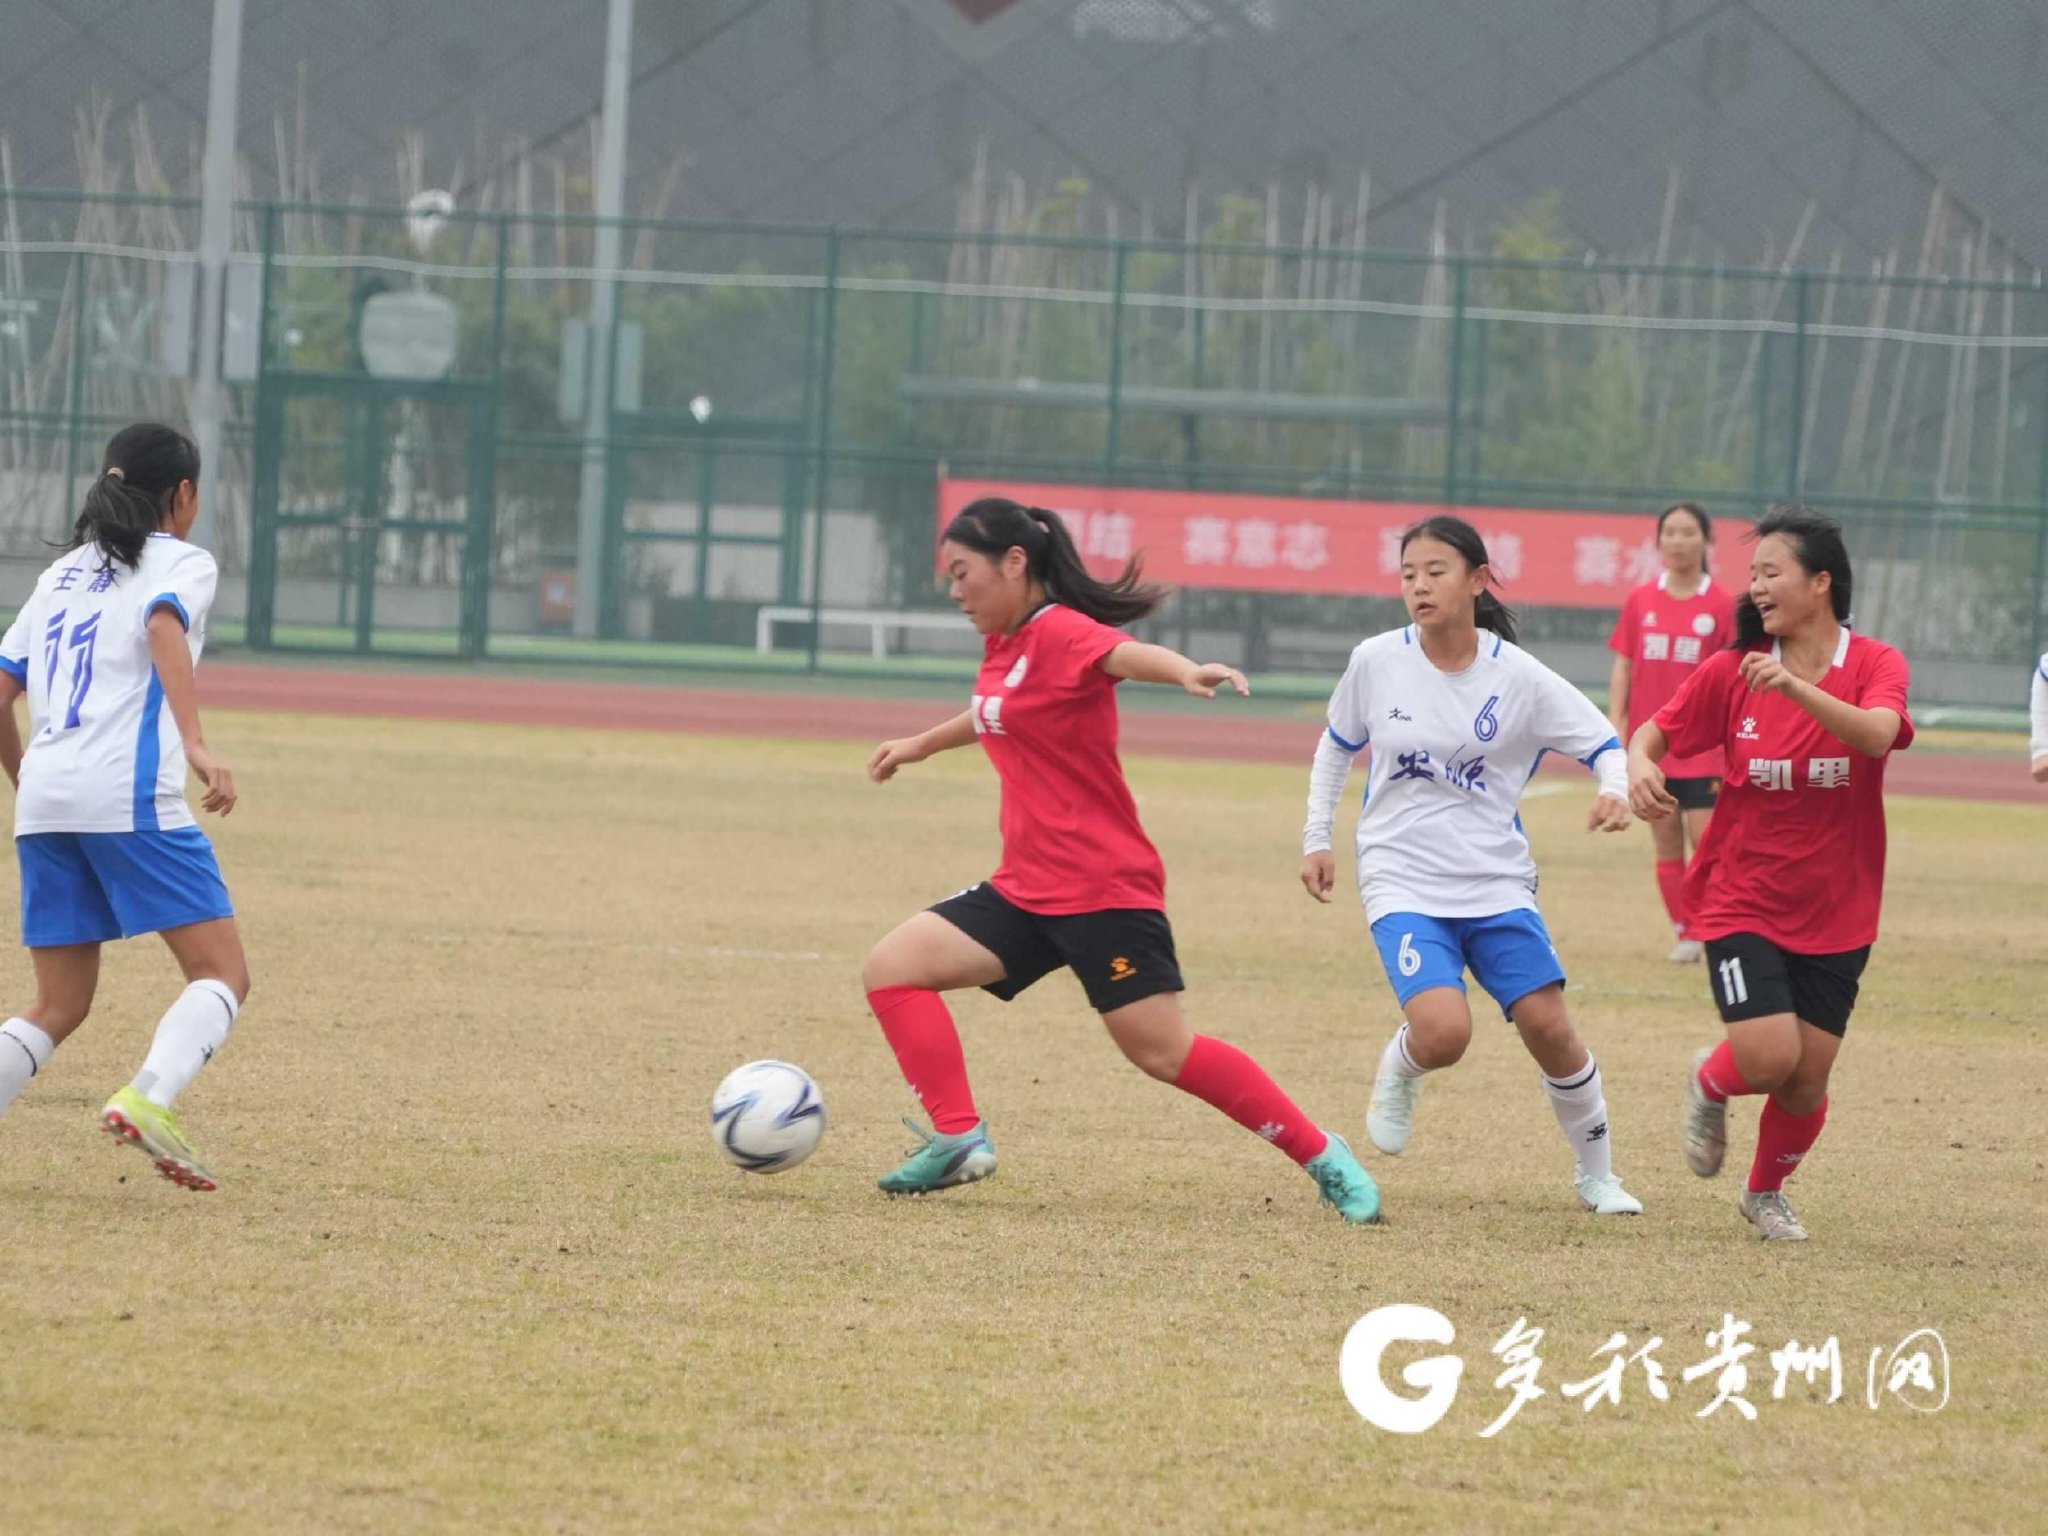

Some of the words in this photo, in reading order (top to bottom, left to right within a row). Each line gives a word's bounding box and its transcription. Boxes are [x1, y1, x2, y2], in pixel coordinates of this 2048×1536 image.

[1475, 696, 1499, 742] 6
[1748, 756, 1851, 791] 凯里
[1398, 932, 1421, 977] 6
[1719, 956, 1749, 1006] 11
